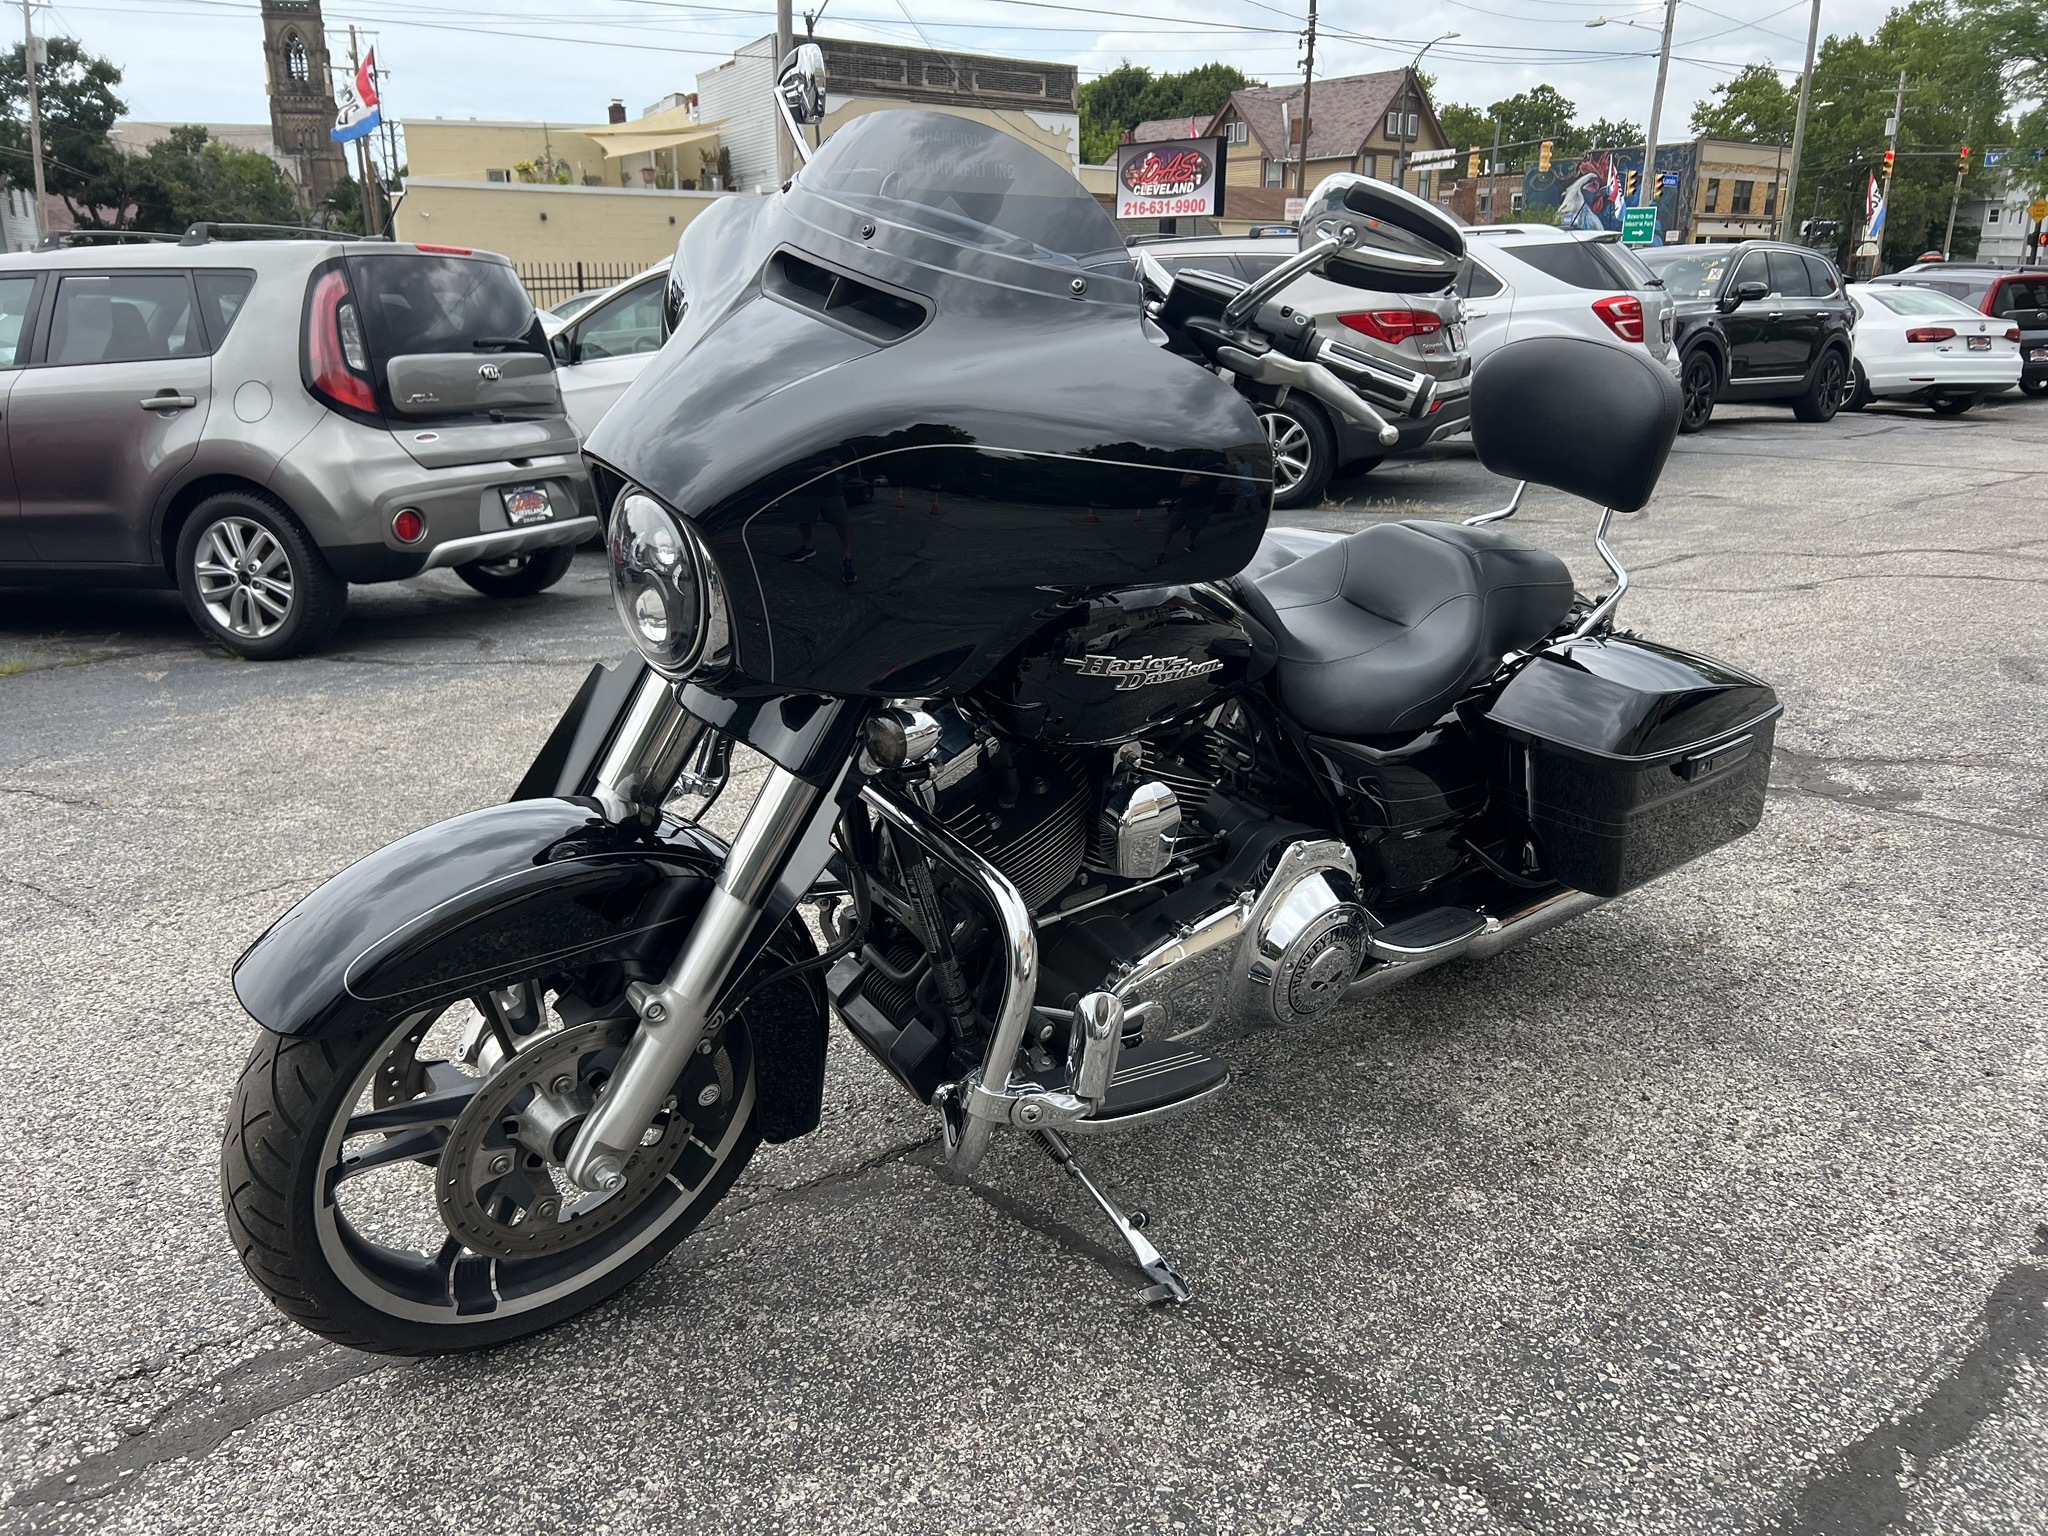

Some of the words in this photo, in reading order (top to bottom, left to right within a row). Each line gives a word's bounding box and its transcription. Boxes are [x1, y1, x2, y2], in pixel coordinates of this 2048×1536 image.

[914, 130, 983, 148] CHAMPION
[913, 157, 988, 178] EQUIPMENT
[1140, 151, 1199, 184] DAS
[1133, 182, 1195, 196] CLEVELAND
[1124, 198, 1206, 216] 216-631-9900
